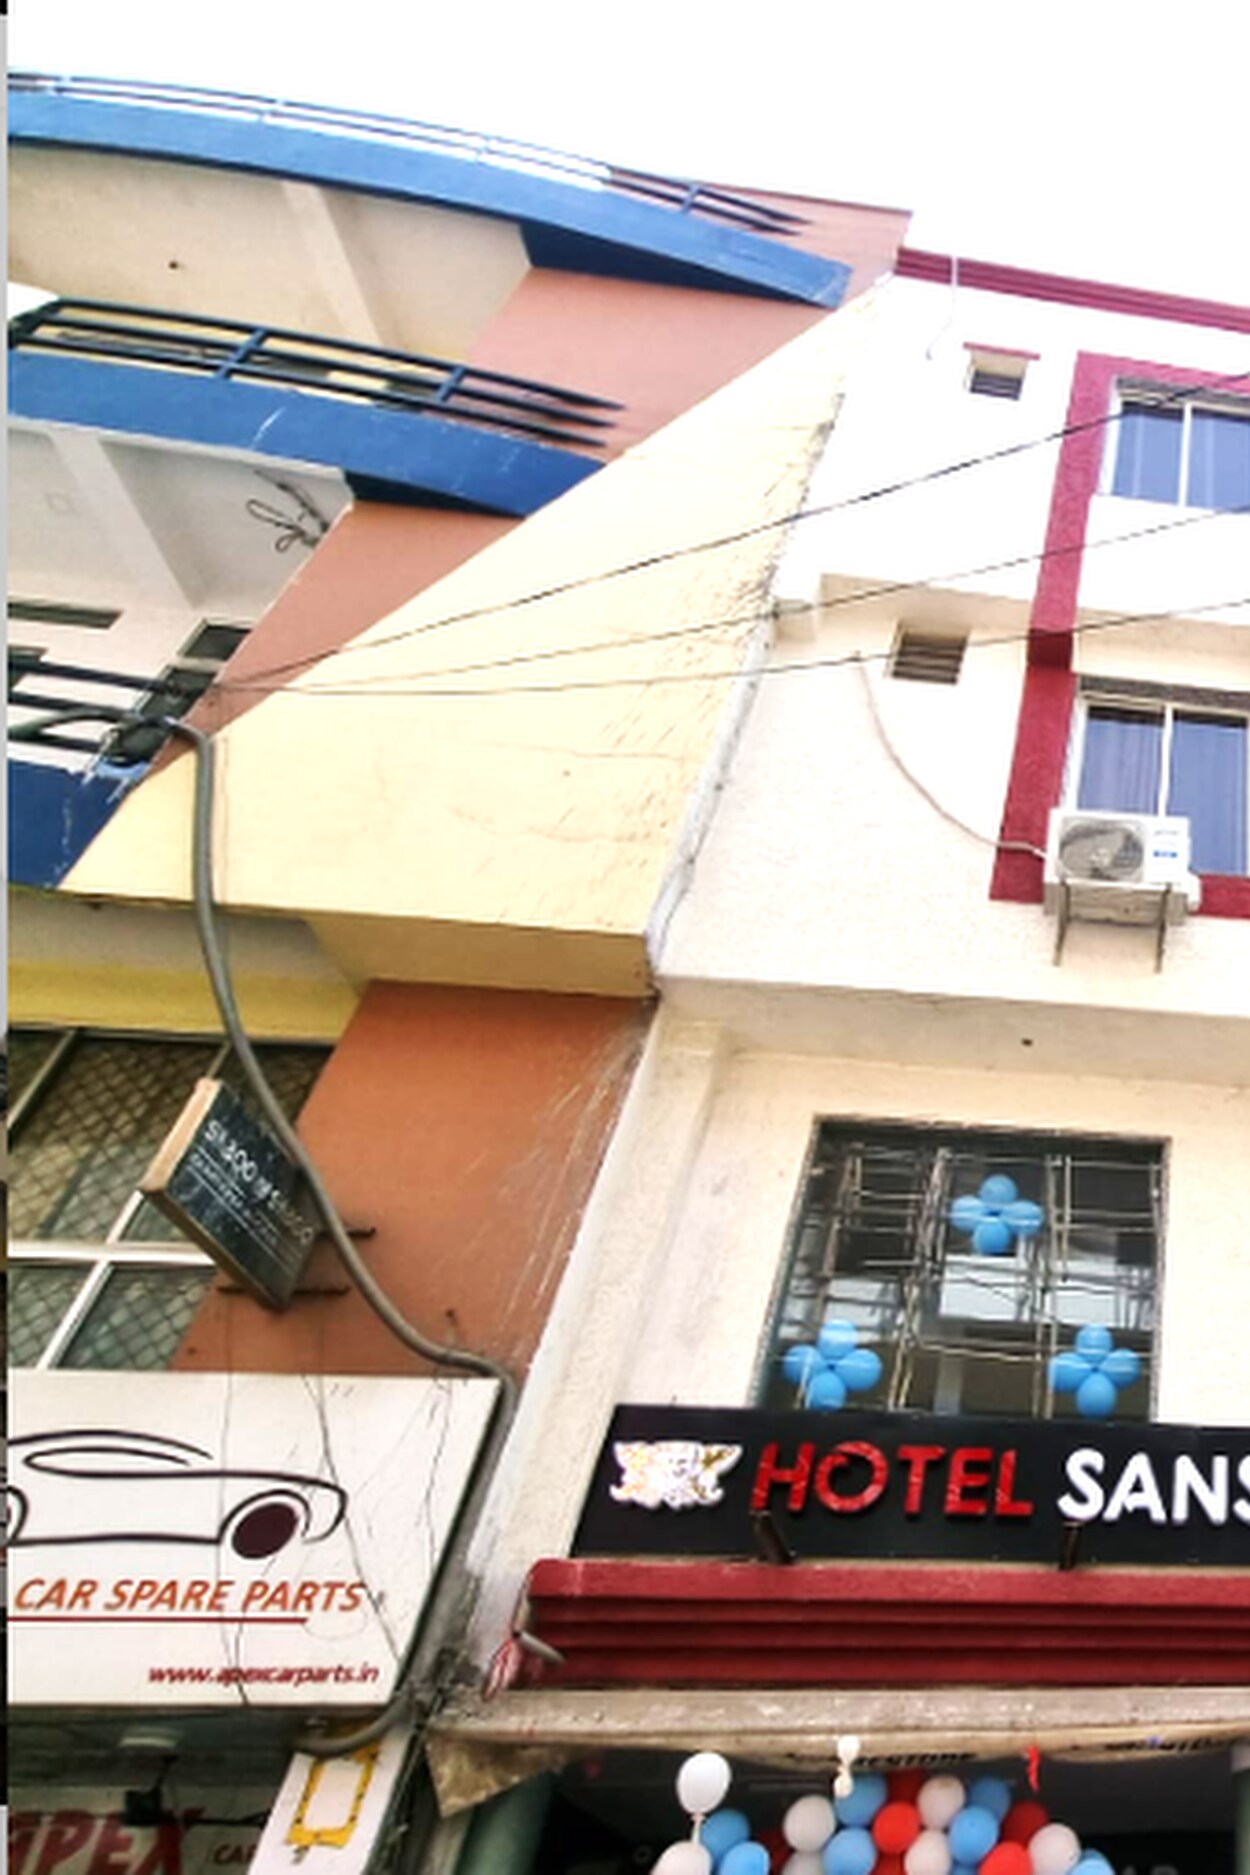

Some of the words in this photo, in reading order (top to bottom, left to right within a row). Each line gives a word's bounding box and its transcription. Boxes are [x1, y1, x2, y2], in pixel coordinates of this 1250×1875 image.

[751, 1440, 1034, 1517] HOTEL
[14, 1578, 99, 1611] CAR
[103, 1579, 235, 1612] SPARE
[241, 1580, 367, 1612] PARTS
[149, 1662, 380, 1687] www.apexcarparts.in
[213, 1843, 257, 1866] CA
